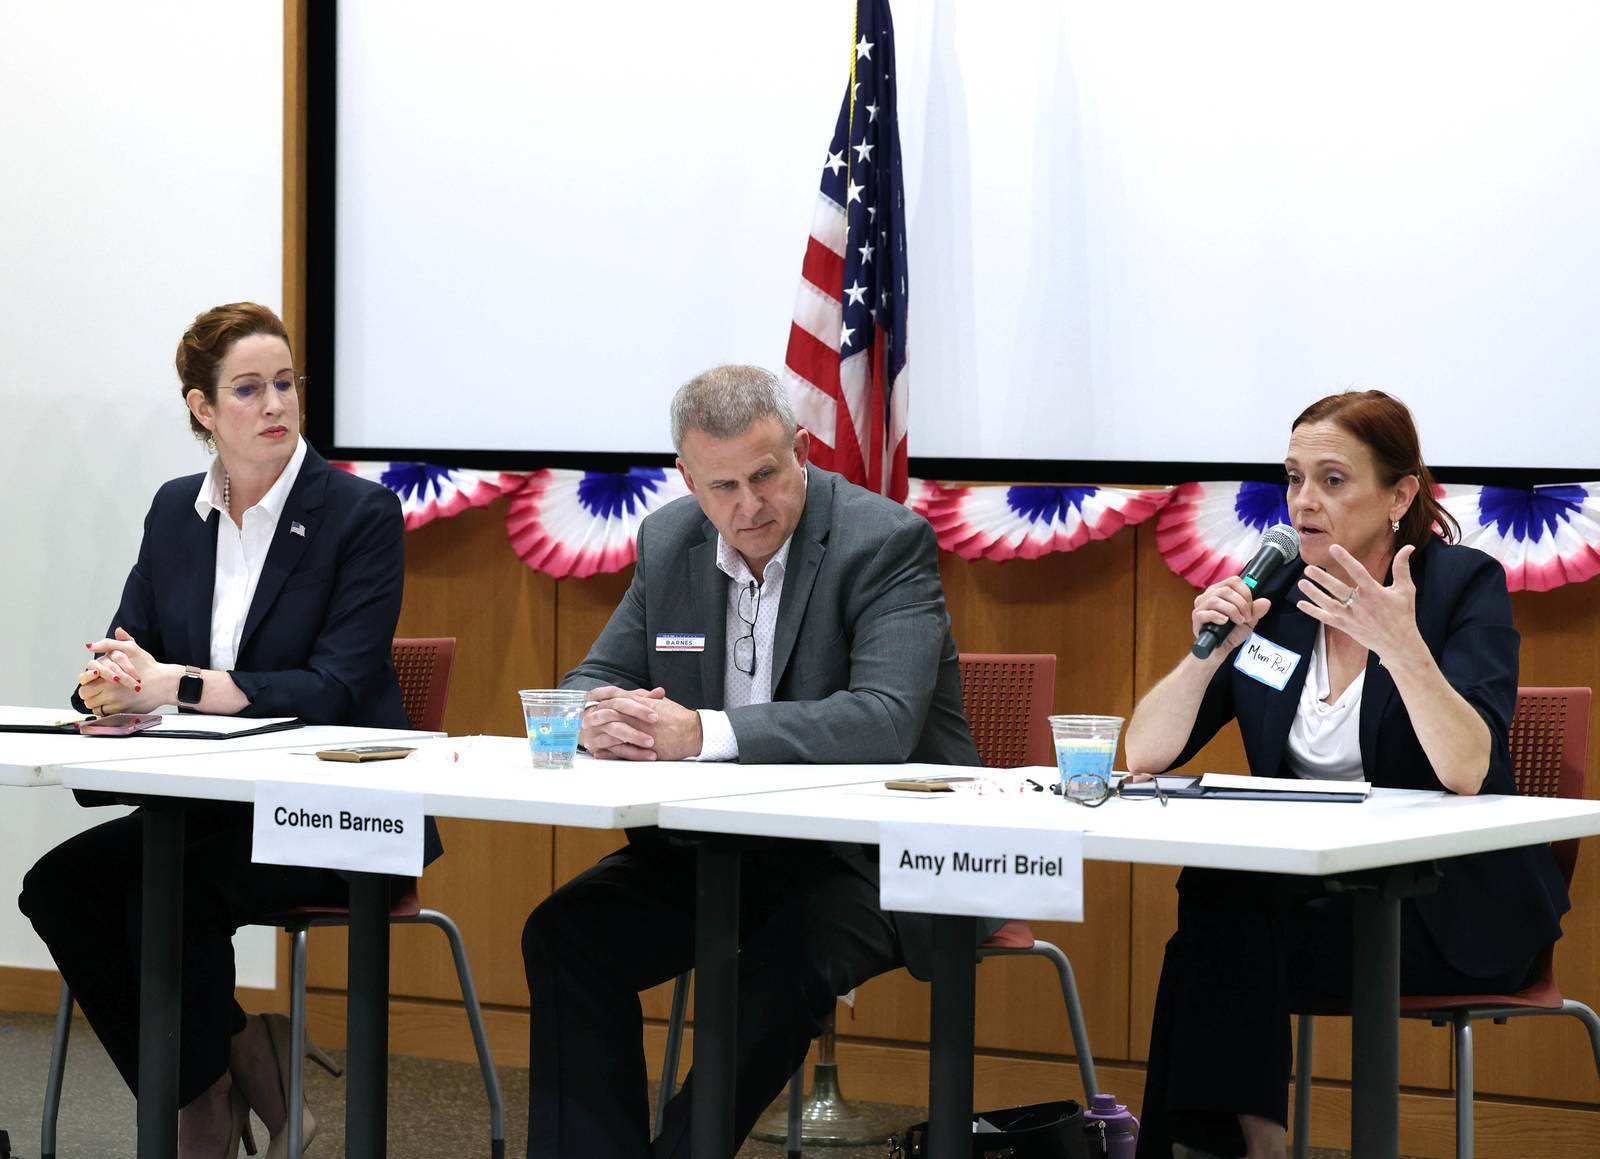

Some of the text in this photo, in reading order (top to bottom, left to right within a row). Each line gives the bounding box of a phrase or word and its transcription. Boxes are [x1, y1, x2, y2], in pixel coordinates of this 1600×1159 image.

[274, 806, 404, 834] Cohen Barnes
[899, 849, 1063, 877] Amy Murri Briel
